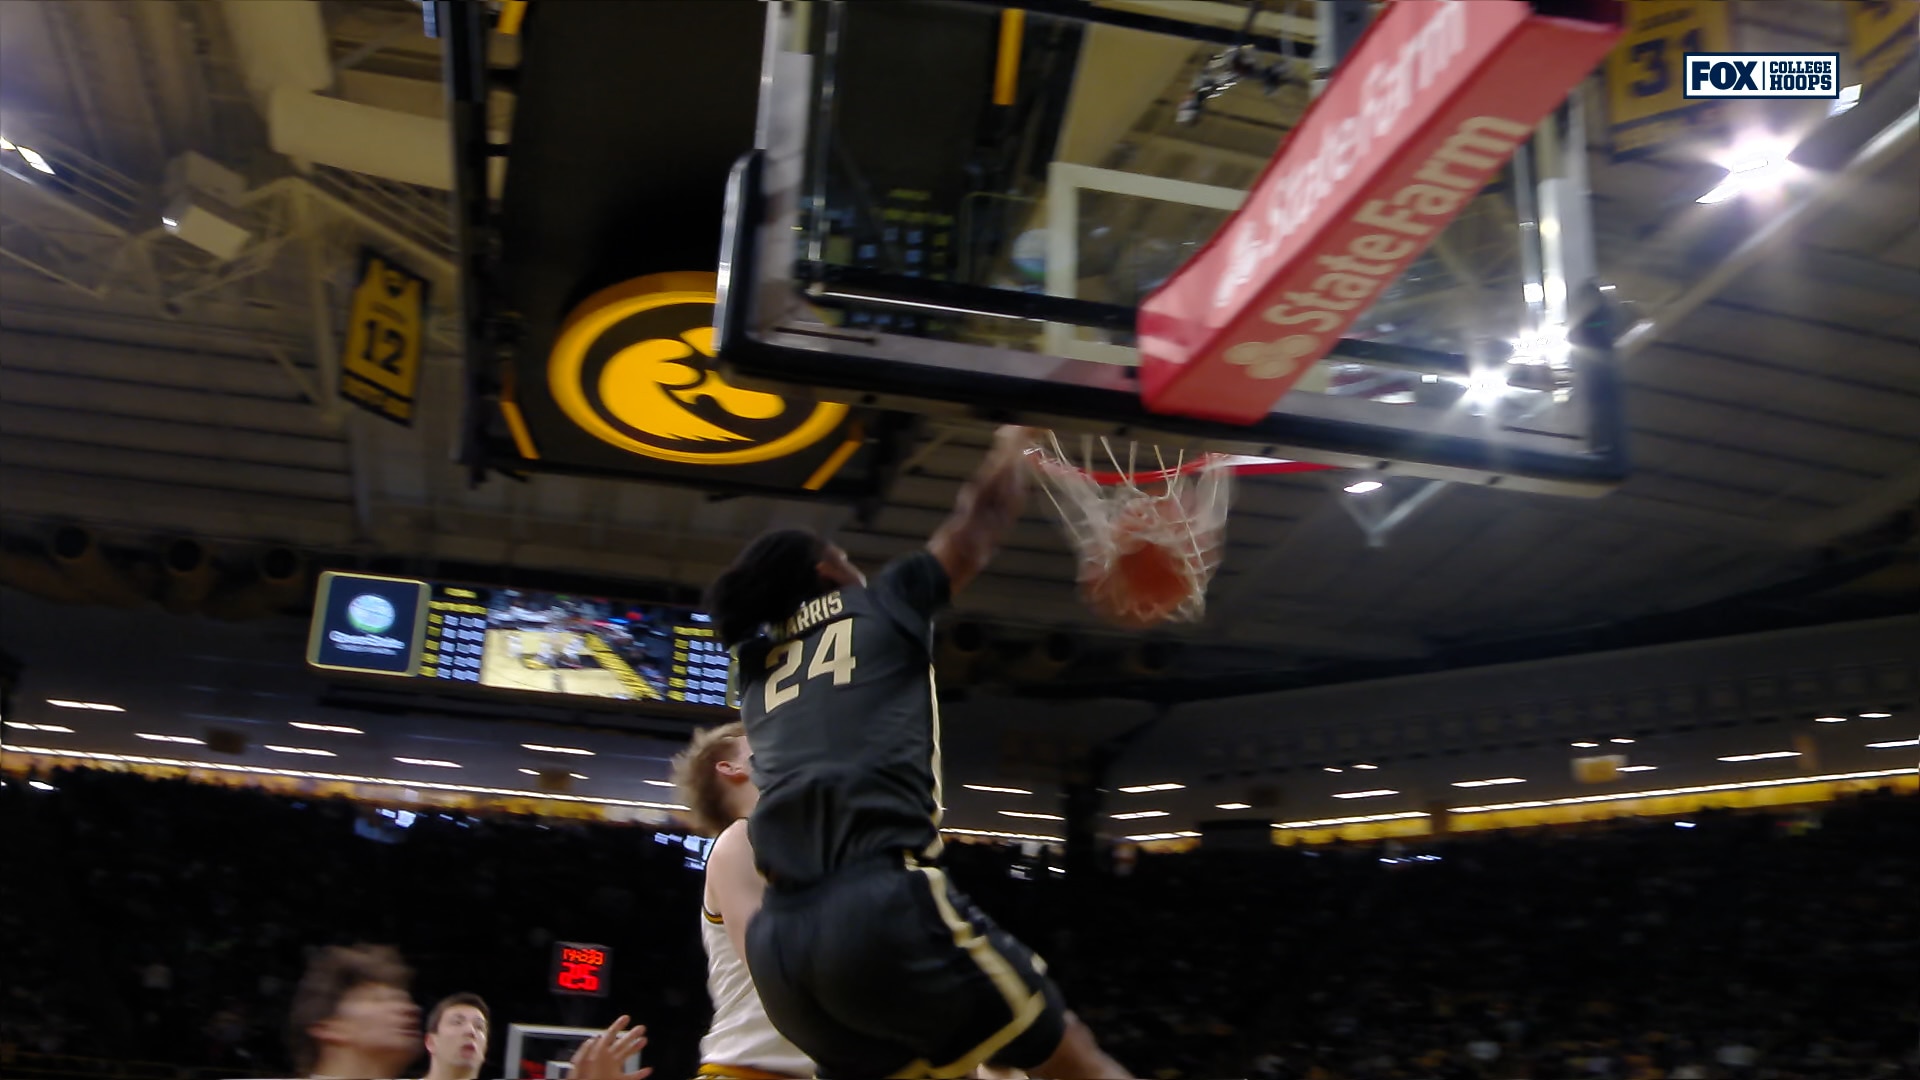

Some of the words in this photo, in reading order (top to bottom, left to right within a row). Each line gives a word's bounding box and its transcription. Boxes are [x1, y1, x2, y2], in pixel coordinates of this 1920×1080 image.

[1263, 115, 1532, 332] StateFarm
[361, 319, 406, 376] 12
[775, 590, 844, 638] ARRIS
[764, 618, 856, 713] 24
